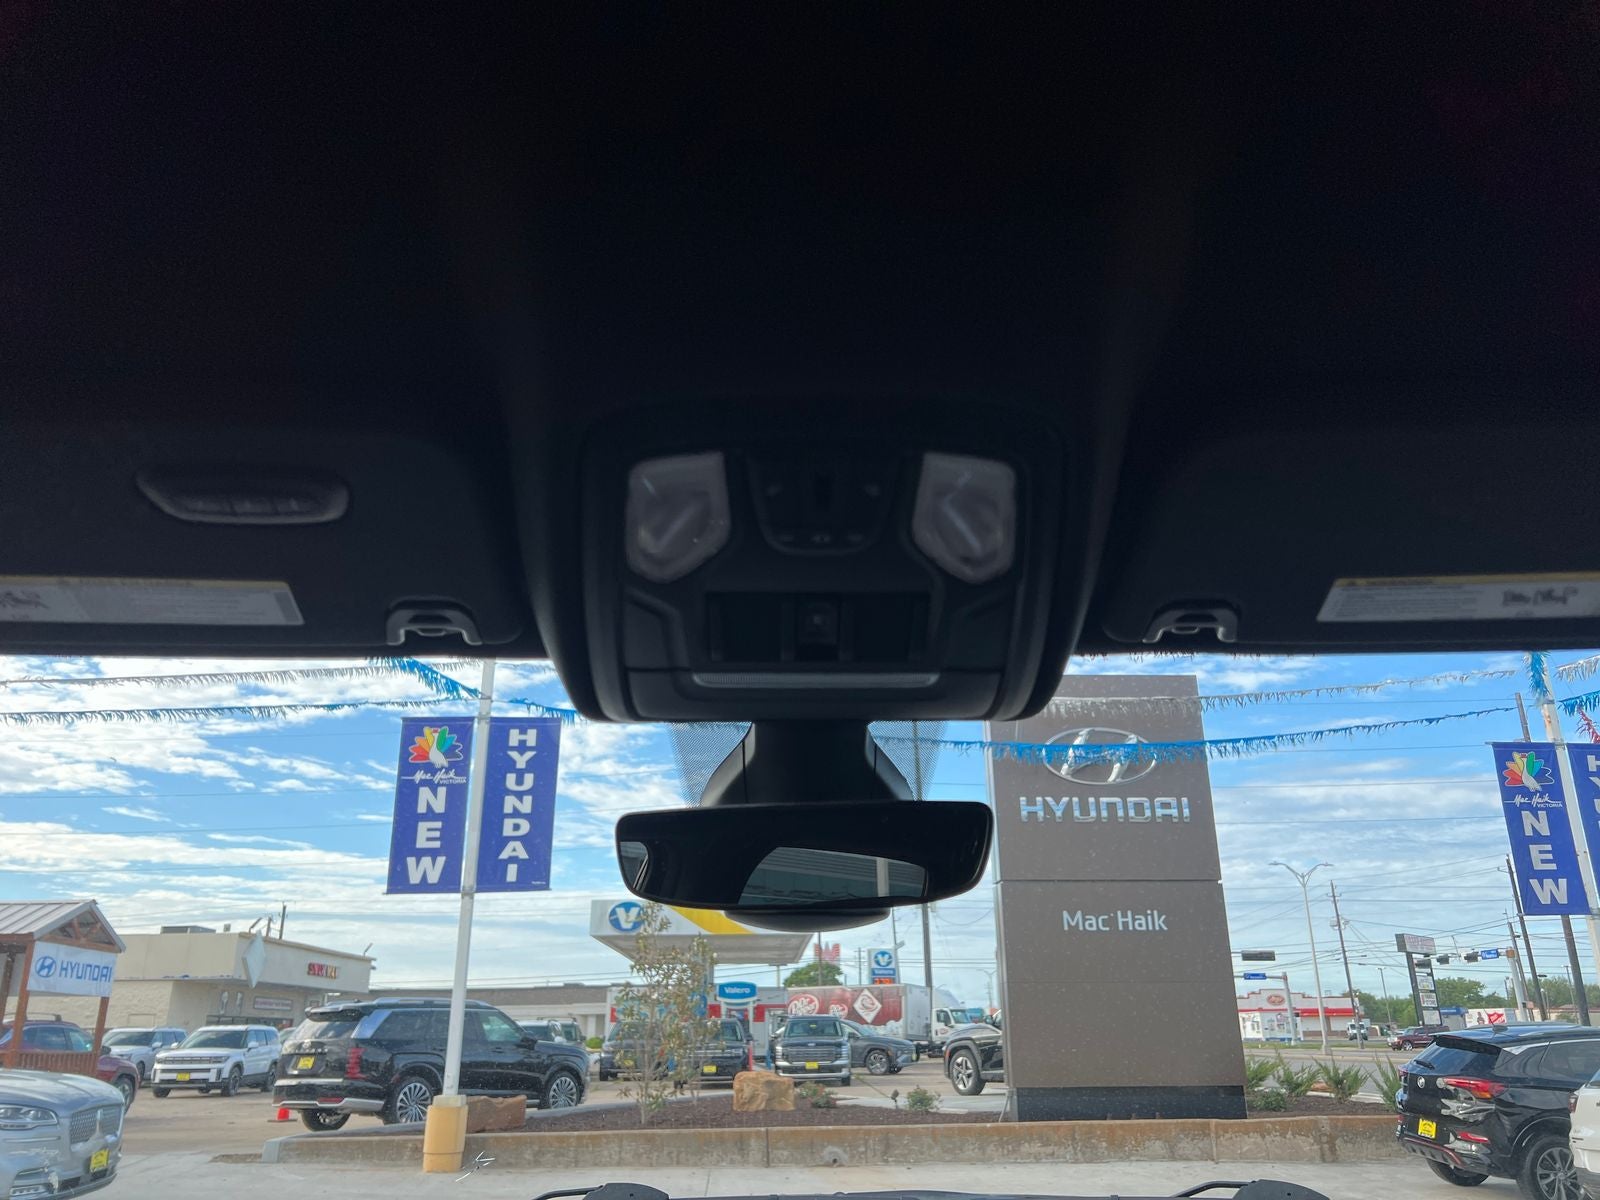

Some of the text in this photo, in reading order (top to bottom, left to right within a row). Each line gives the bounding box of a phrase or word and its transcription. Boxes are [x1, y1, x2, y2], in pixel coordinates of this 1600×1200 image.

[498, 728, 537, 883] HYUNDAI
[1019, 797, 1190, 823] HYUNDAI
[406, 786, 447, 885] NEW
[1521, 811, 1568, 905] NEW
[1062, 909, 1168, 931] Mac Haik
[59, 960, 113, 983] HYUNDAI
[723, 986, 751, 995] Valero
